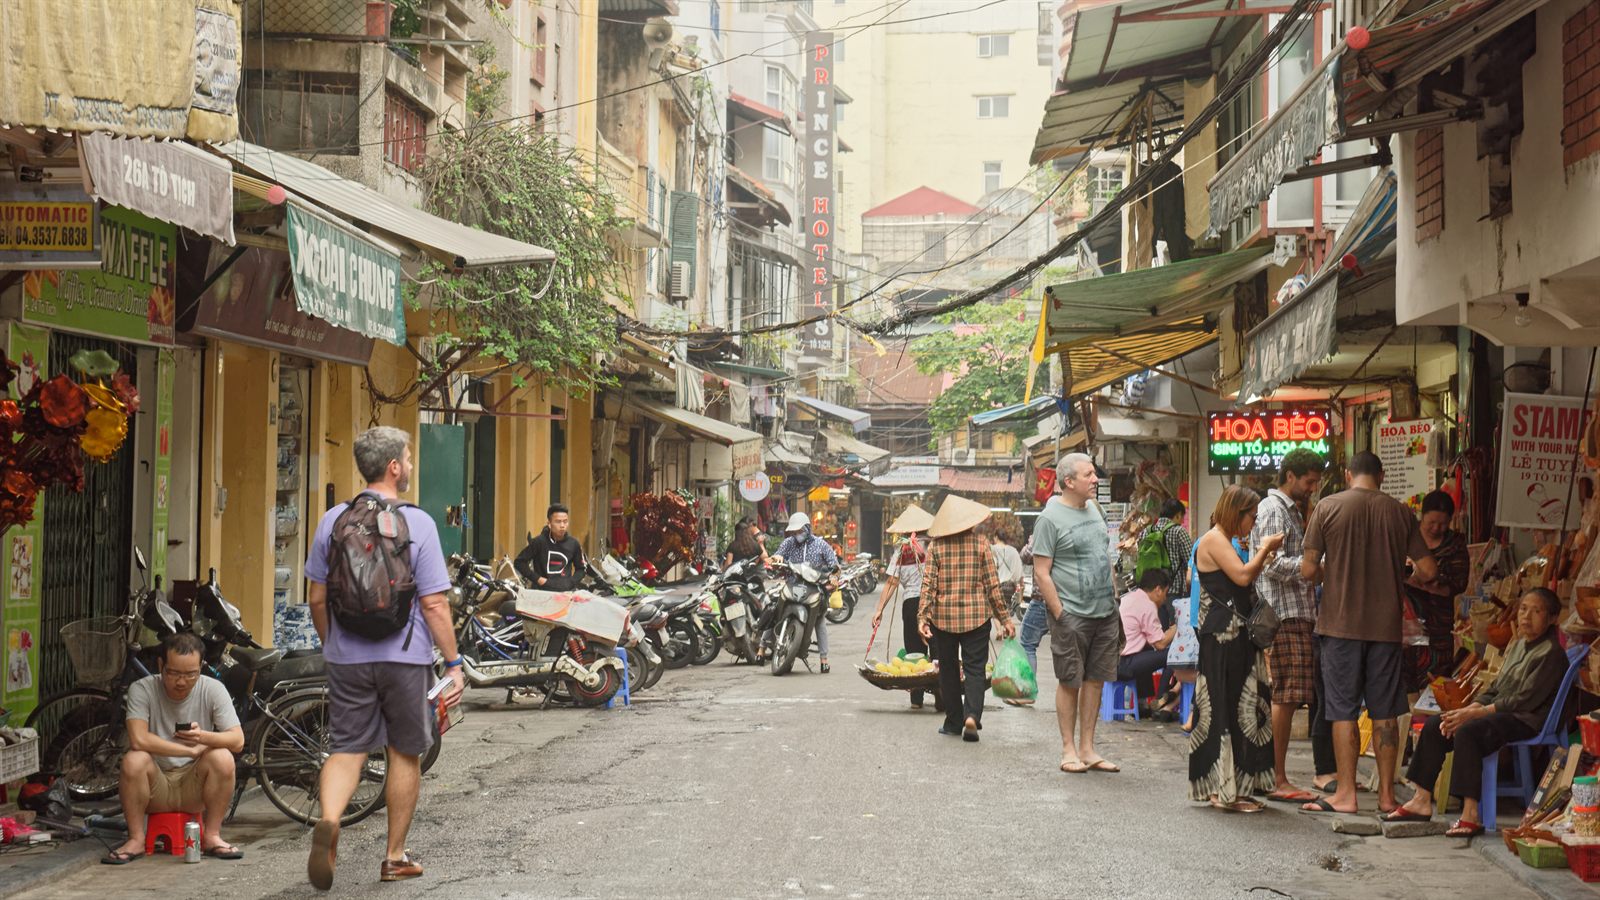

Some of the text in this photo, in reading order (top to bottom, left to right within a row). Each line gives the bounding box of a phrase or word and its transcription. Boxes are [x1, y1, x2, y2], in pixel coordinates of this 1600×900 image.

[123, 155, 149, 191] 26A
[813, 44, 829, 308] PRINCE HOTEL
[16, 226, 87, 246] 04.3537.6838
[100, 219, 168, 287] WAFFLE
[295, 224, 346, 301] NGOẠI
[349, 252, 396, 313] CHUNG
[1214, 418, 1269, 441] HOA
[1380, 425, 1407, 437] HOA
[1213, 441, 1243, 456] SINH
[1271, 441, 1297, 455] HOA
[1511, 440, 1536, 453] WITH
[1538, 442, 1562, 455] YOUR
[1239, 455, 1252, 467] 17
[1253, 453, 1271, 467] TÔ
[1511, 453, 1532, 470] LÊ
[769, 475, 784, 484] CE
[1520, 472, 1531, 480] 19
